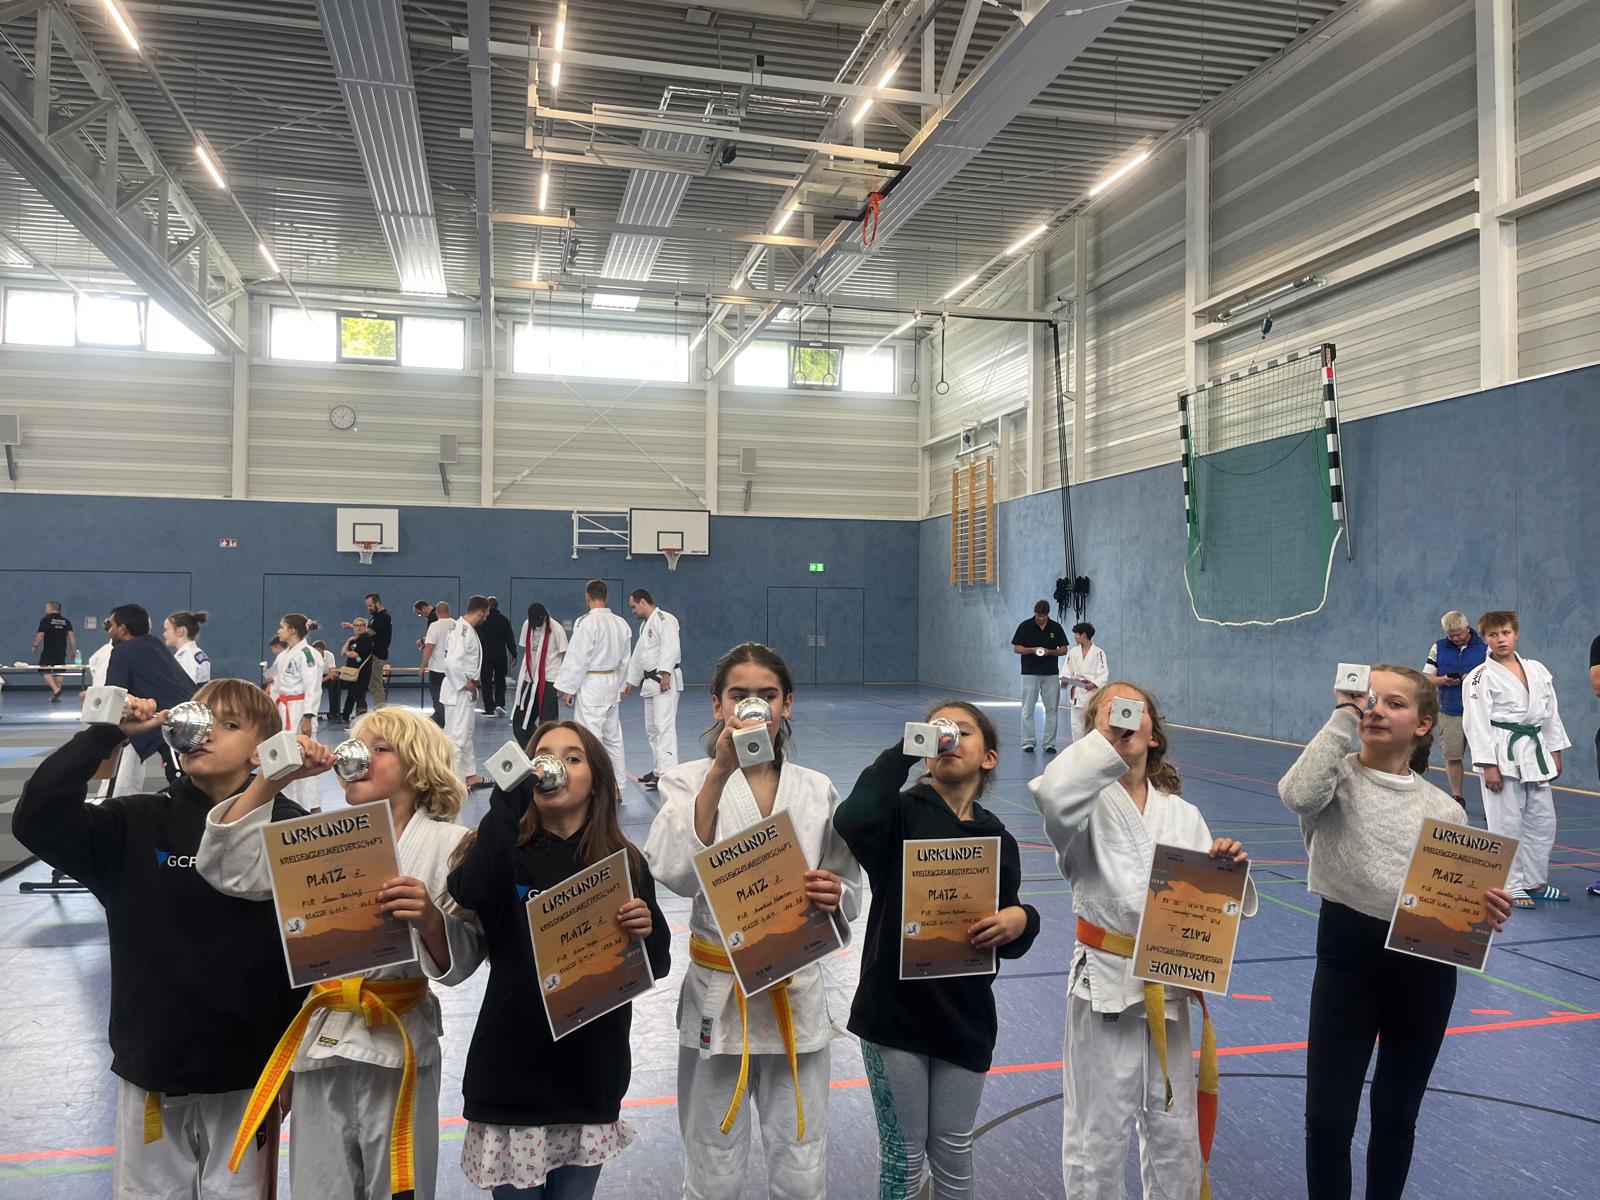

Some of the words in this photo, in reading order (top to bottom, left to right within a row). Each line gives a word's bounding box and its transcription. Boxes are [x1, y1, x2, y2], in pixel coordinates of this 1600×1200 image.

[281, 814, 370, 846] URKUNDE
[1432, 827, 1502, 854] URKUNDE
[709, 824, 779, 869] URKUNDE
[917, 846, 983, 862] URKUNDE
[306, 867, 347, 889] PLATZ
[1432, 868, 1464, 885] PLATZ
[542, 866, 611, 914] URKUNDE
[736, 878, 769, 905] PLATZ
[928, 888, 958, 901] PLATZ
[560, 919, 592, 945] PLATZ
[1181, 927, 1212, 943] PLATZ
[1149, 960, 1216, 984] URKUNDE
